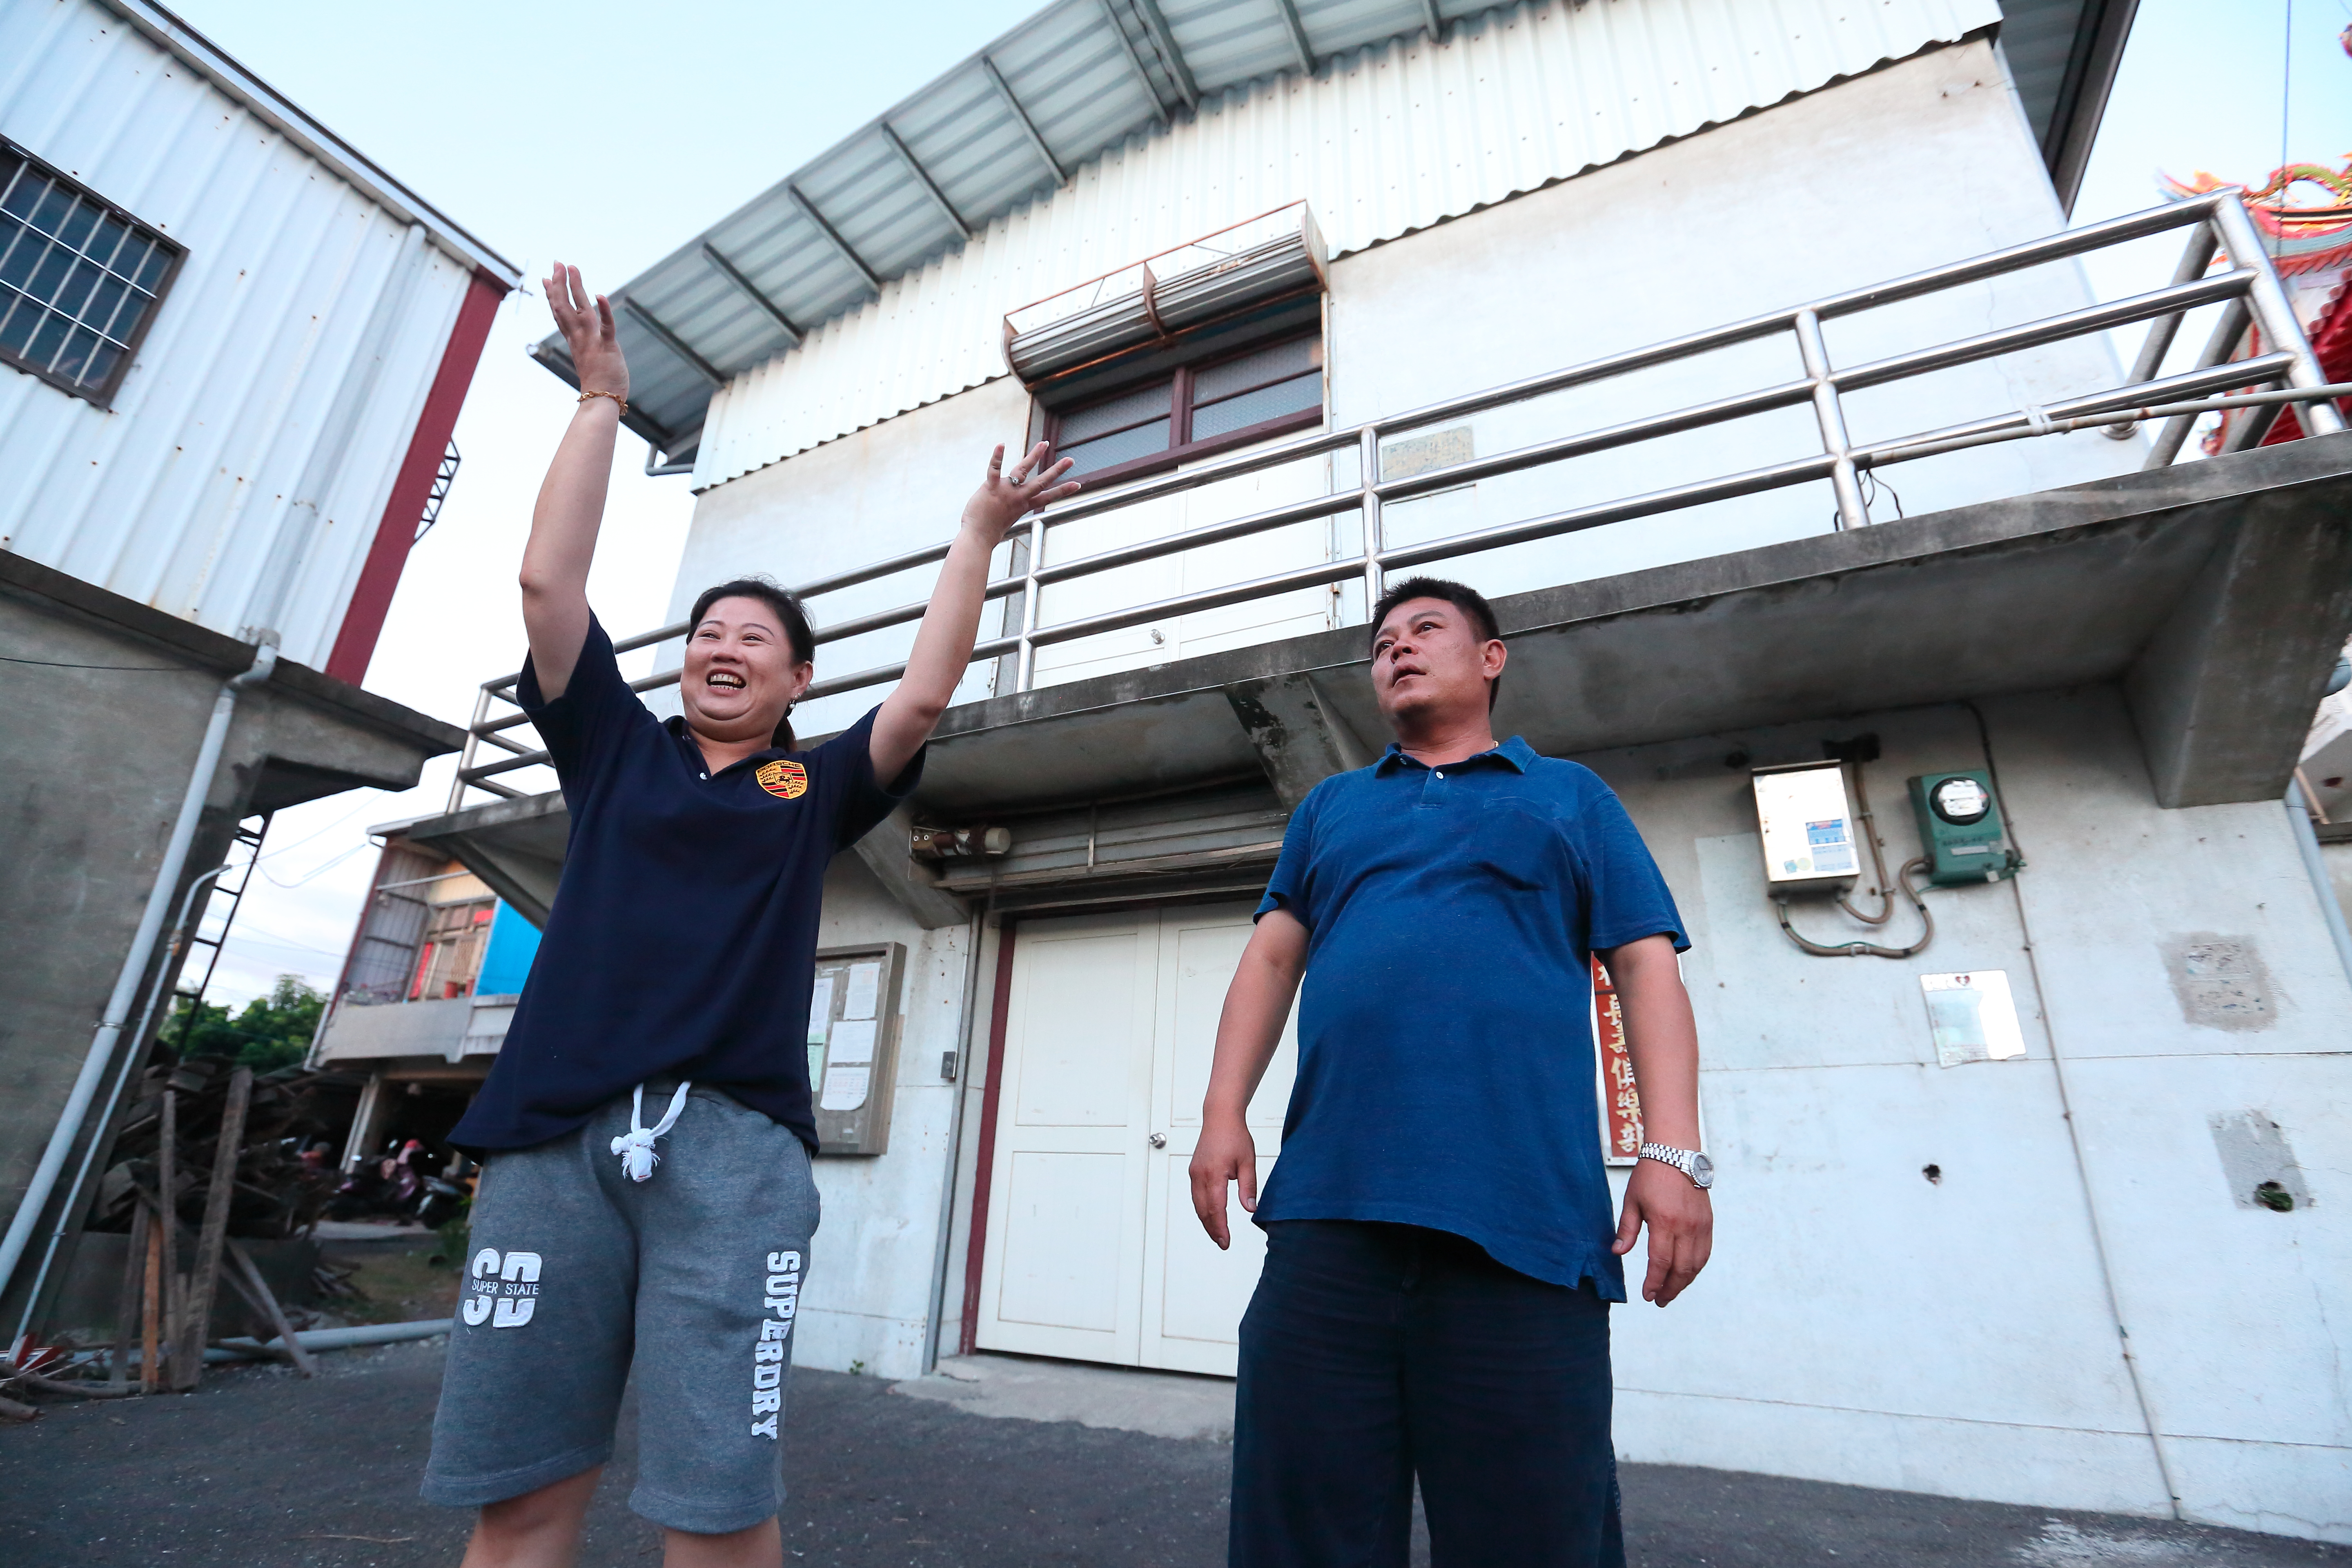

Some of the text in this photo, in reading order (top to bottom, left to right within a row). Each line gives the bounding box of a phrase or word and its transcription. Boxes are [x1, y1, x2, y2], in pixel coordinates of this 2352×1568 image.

[757, 762, 801, 773] PORSCHE
[472, 1279, 540, 1295] SUPER STATE
[751, 1250, 801, 1440] SUPERDRY
